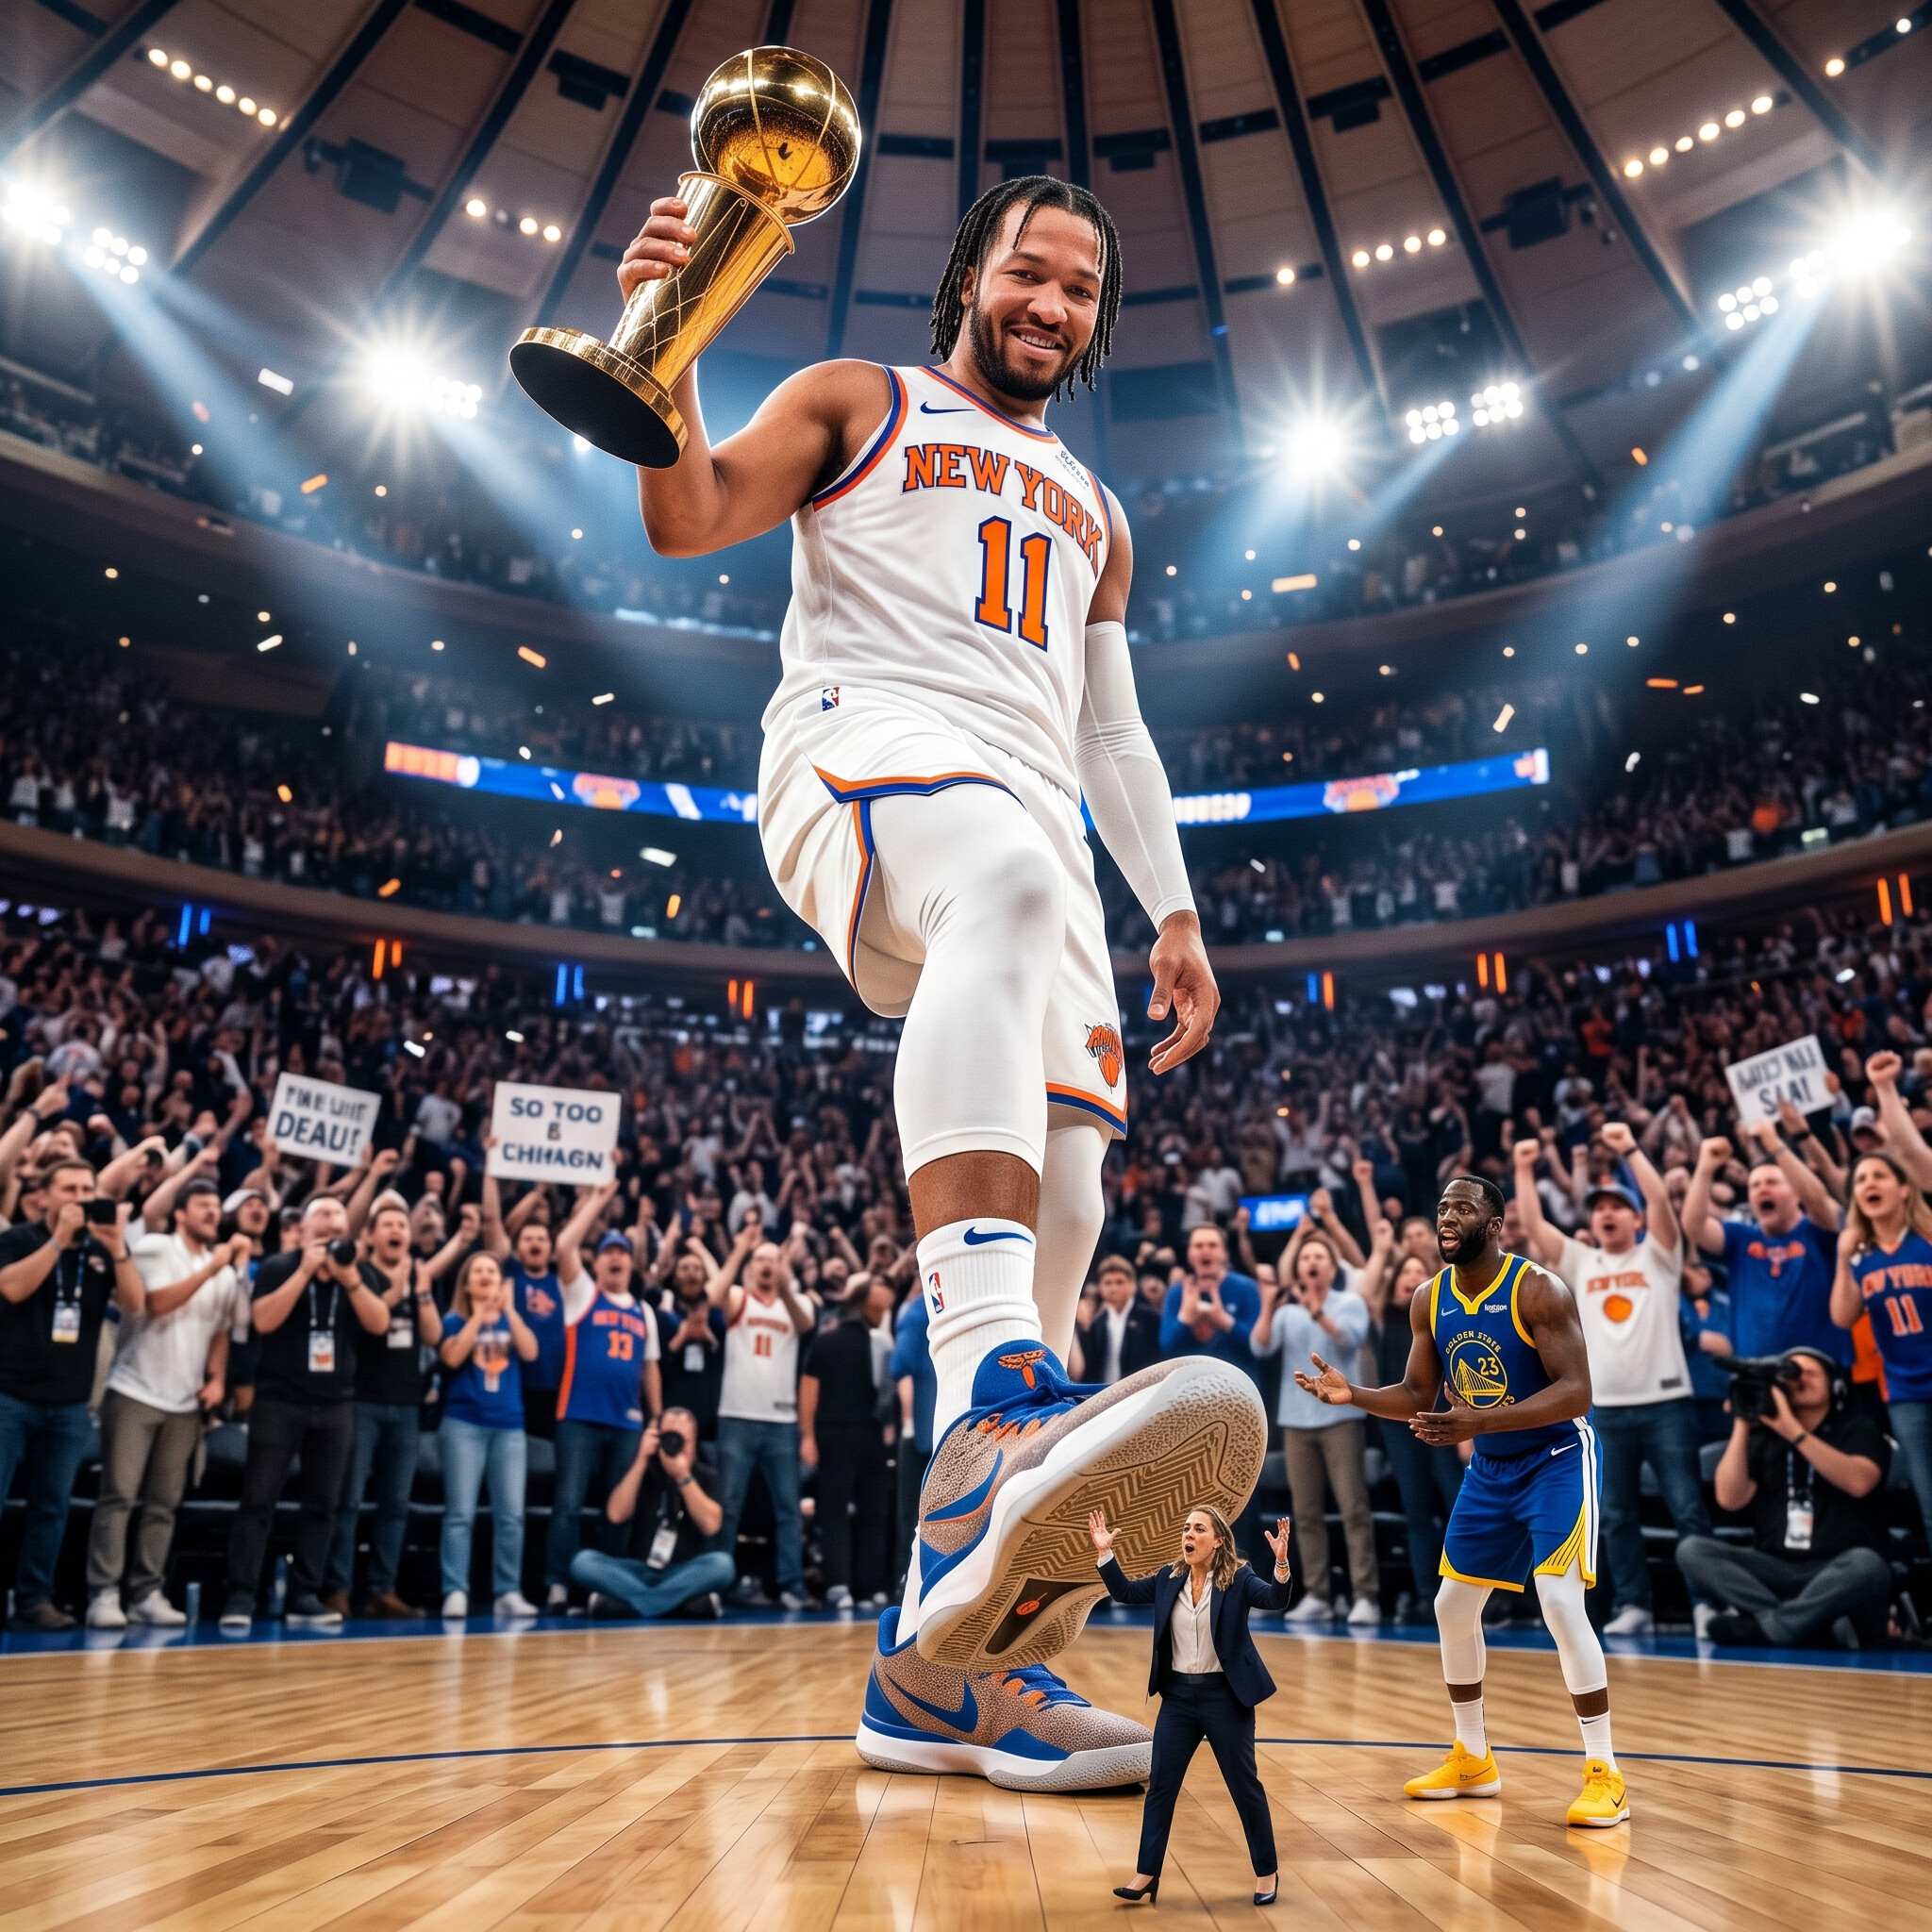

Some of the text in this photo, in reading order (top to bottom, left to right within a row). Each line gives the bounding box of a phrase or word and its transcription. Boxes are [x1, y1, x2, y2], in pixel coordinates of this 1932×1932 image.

[902, 442, 1010, 496] NEW
[1014, 459, 1103, 581] YORK
[974, 515, 1053, 654] 11
[509, 1096, 604, 1124] SO TOO
[1884, 1293, 1924, 1336] 11
[1477, 1357, 1500, 1376] 23
